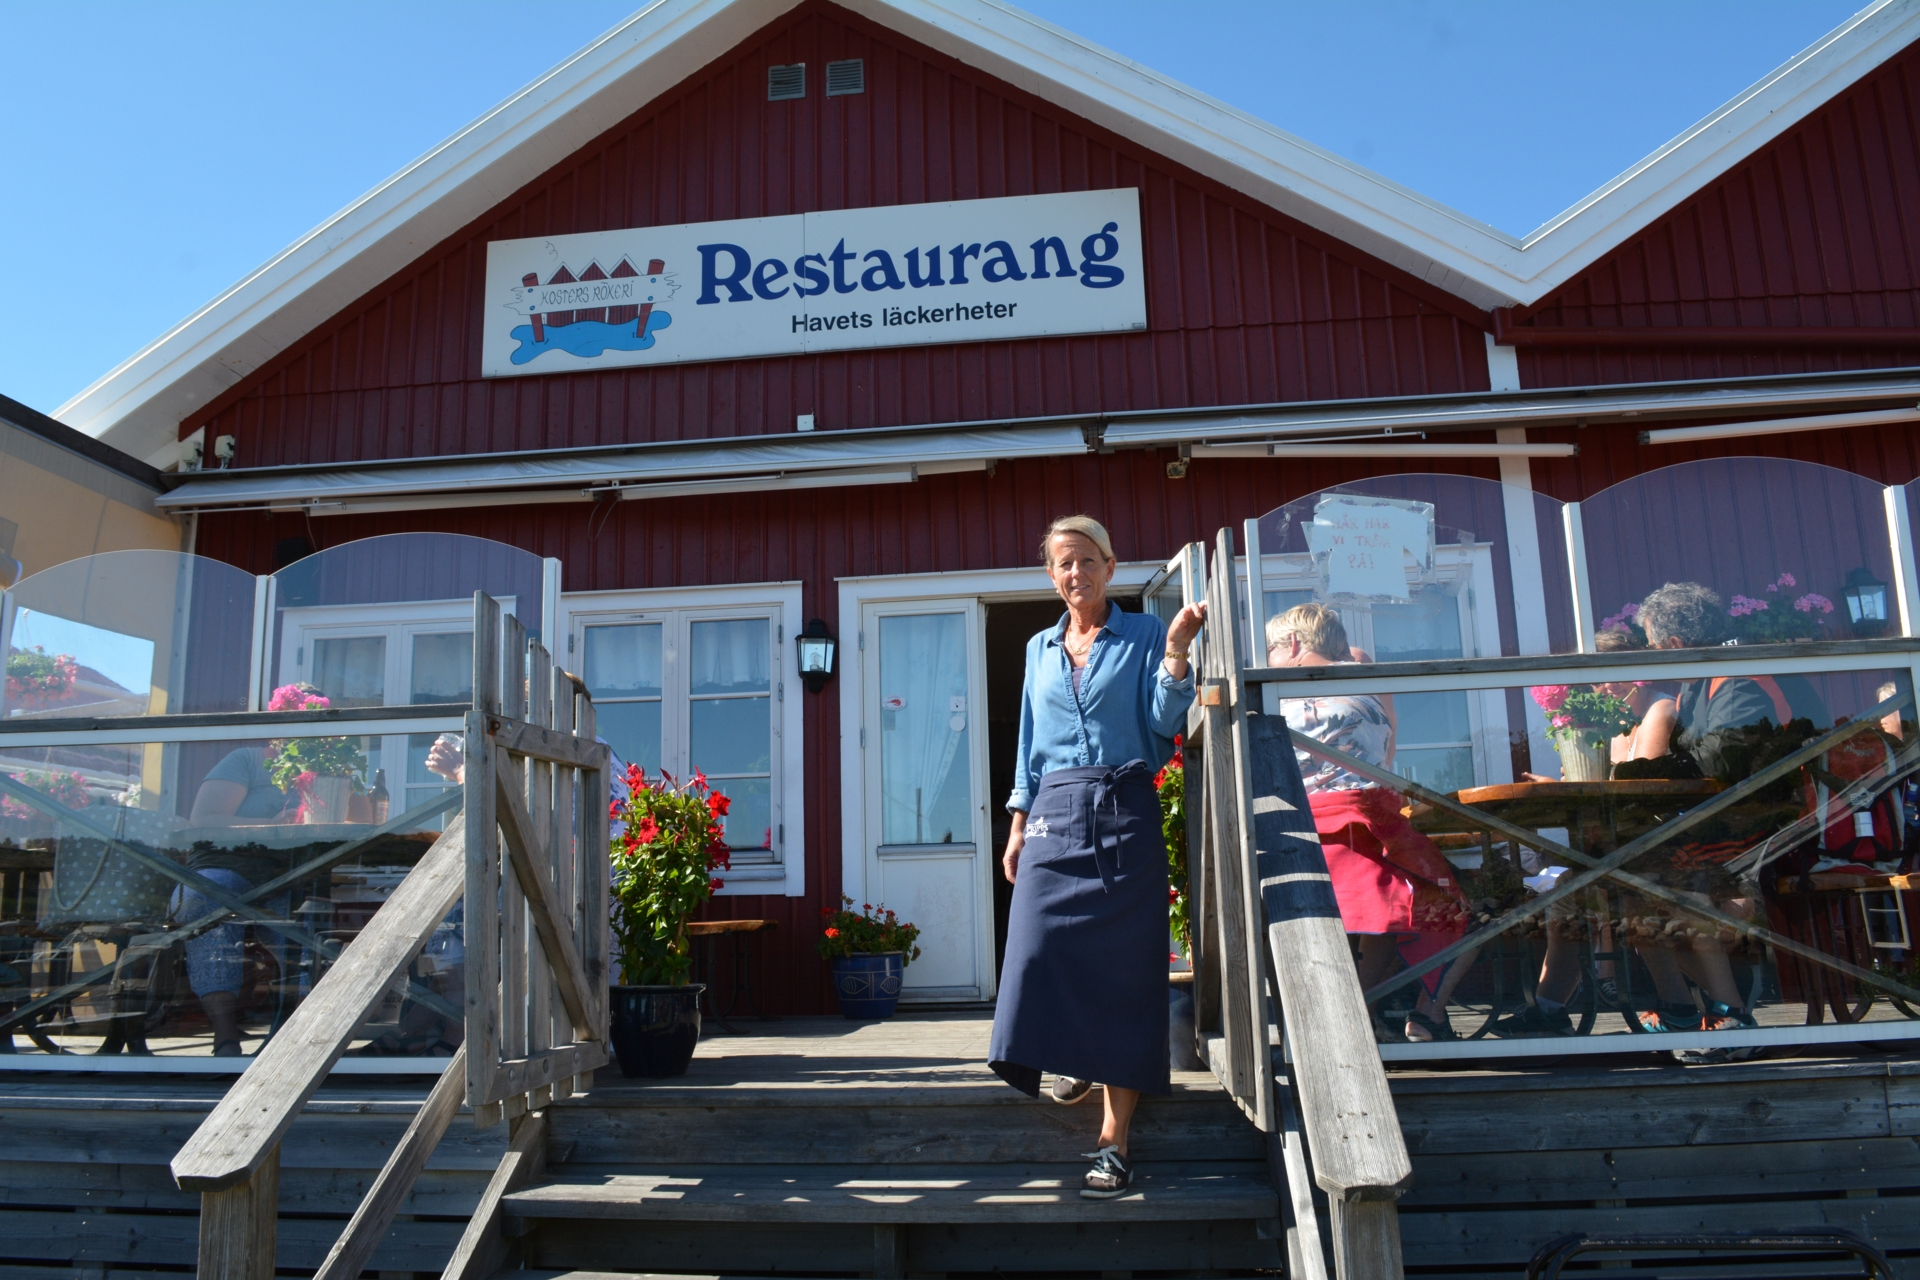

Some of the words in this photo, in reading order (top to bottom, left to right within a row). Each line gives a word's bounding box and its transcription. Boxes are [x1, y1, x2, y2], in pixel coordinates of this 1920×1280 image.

[695, 221, 1125, 304] Restaurang
[540, 287, 590, 306] KOSTERS
[592, 280, 635, 302] RÖKERI
[791, 309, 873, 333] Havets
[883, 301, 1017, 326] läckerheter
[1365, 517, 1390, 530] HAR
[1332, 535, 1345, 545] VI
